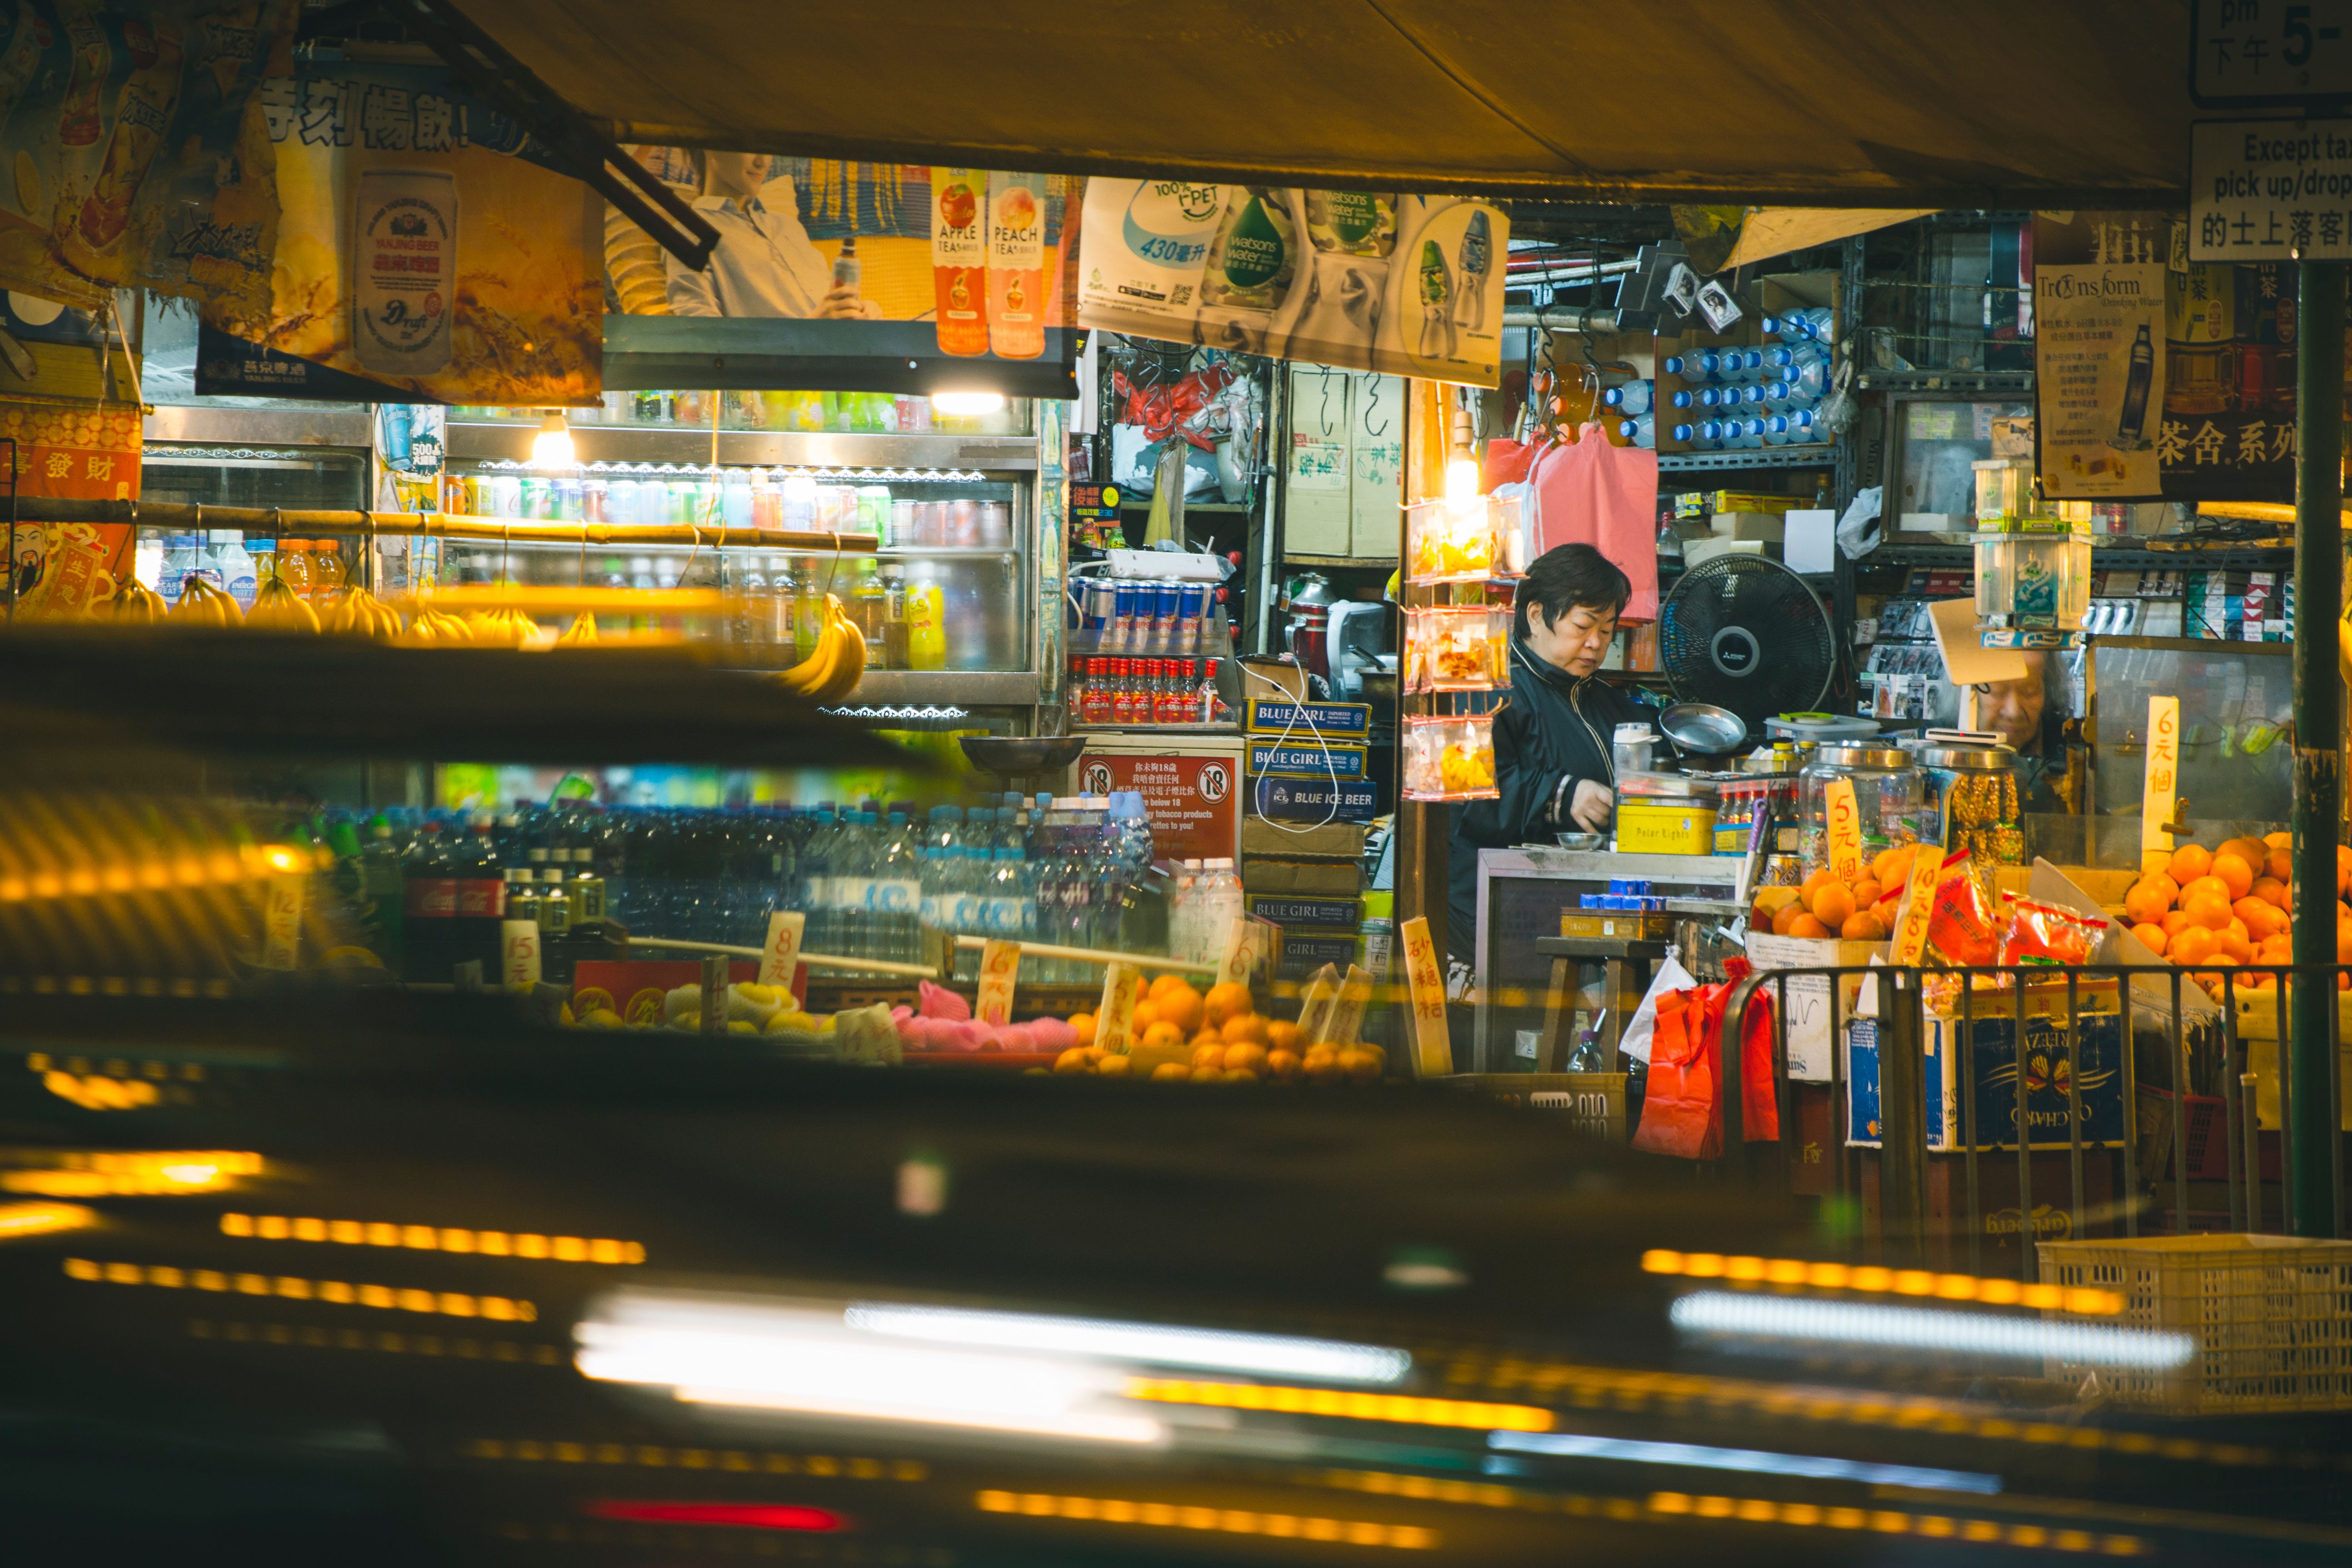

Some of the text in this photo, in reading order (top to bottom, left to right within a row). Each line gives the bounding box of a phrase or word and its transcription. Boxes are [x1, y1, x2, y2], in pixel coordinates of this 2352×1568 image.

[2208, 35, 2270, 75] 下午
[2244, 134, 2320, 172] Except
[2215, 170, 2260, 203] pick
[1327, 191, 1367, 205] watsons
[1326, 204, 1355, 217] water
[939, 225, 976, 240] APPLE
[995, 227, 1037, 242] PEACH
[2202, 209, 2352, 248] 的士上落客
[939, 241, 957, 253] TEA
[995, 243, 1014, 255] TEA
[1141, 237, 1206, 263] 430毫升
[1231, 235, 1277, 252] watsons
[1228, 248, 1261, 262] water
[379, 298, 429, 333] Draft
[1259, 707, 1325, 721] BLUE GIRL
[1255, 751, 1321, 765] BLUE GIRL
[2149, 709, 2173, 794] 6元個
[1135, 762, 1177, 773] 你未夠18歲
[1132, 774, 1180, 785] 我唔會賣任何
[1203, 769, 1224, 796] 18
[1150, 798, 1171, 806] below
[1295, 792, 1372, 805] BLUE ICE BEER
[1155, 810, 1181, 818] tobacco
[1183, 810, 1213, 820] products
[1150, 821, 1194, 831] rettes to you!
[1636, 827, 1690, 840] Polar Lights
[1834, 794, 1858, 883] 5元個
[1256, 904, 1319, 917] BLUE GIRL
[765, 928, 793, 982] 8元
[1287, 943, 1316, 955] GIRL
[508, 936, 534, 983] 15元
[2020, 1031, 2083, 1052] REEZ
[2010, 1104, 2092, 1127] OCHARD
